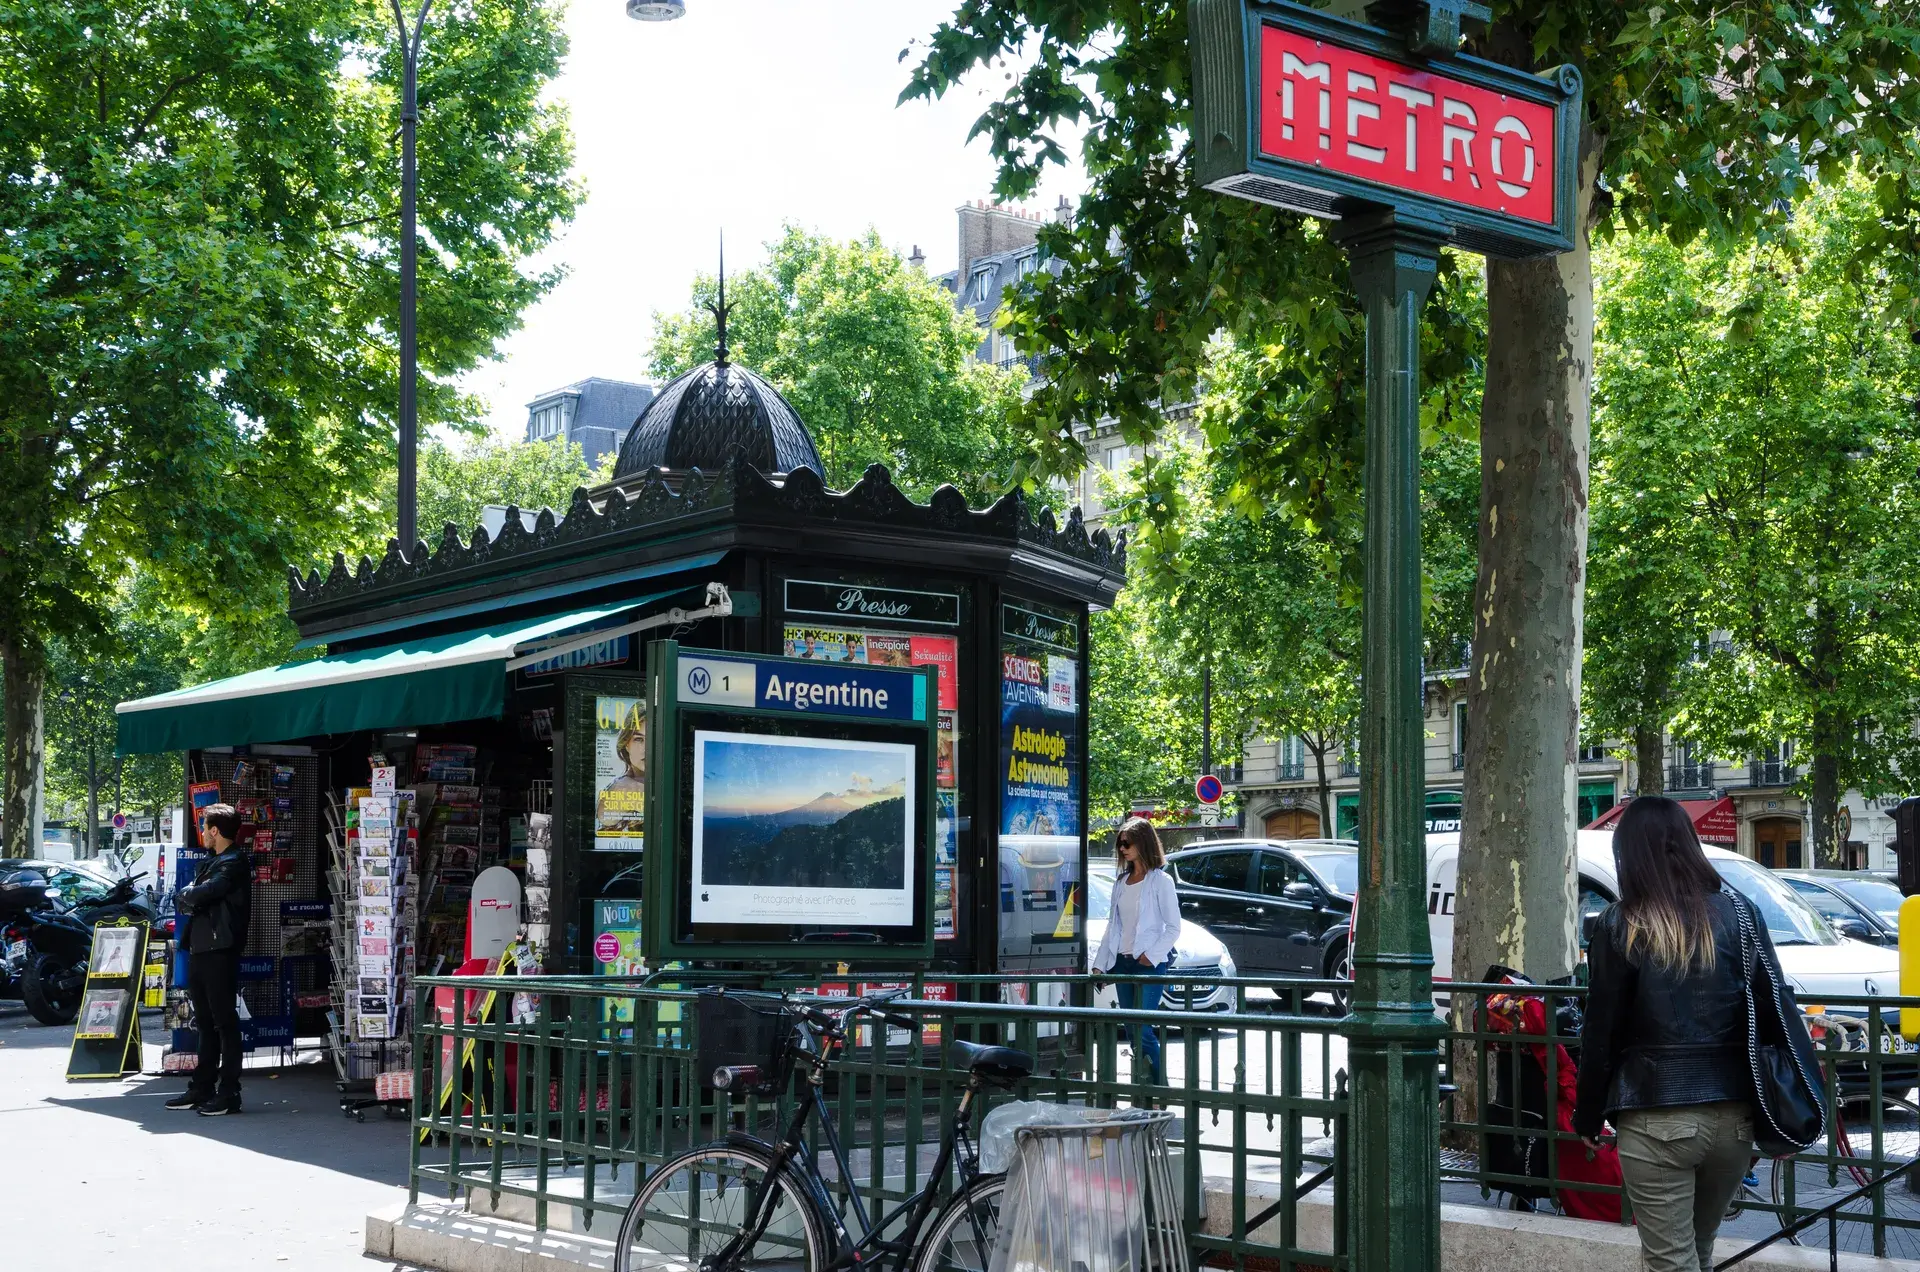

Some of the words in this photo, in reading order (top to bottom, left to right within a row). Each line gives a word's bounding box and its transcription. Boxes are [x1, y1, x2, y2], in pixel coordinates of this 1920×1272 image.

[1282, 50, 1535, 198] METRO
[837, 588, 911, 616] Presse
[1025, 615, 1056, 641] Presse
[869, 639, 910, 652] inexploré
[914, 650, 953, 662] Sexualité
[1004, 656, 1041, 684] SCIENCES
[722, 675, 730, 691] 1
[765, 674, 889, 709] Argentine
[1006, 681, 1041, 705] AVENIR
[1012, 725, 1066, 761] Astrologie
[1008, 755, 1069, 787] Astronomie
[600, 791, 625, 801] PLEIN
[1008, 785, 1014, 796] La
[1014, 785, 1031, 798] science
[1031, 787, 1040, 798] face
[604, 800, 619, 811] SUR
[620, 801, 635, 812] MES
[753, 893, 804, 906] Photographié
[805, 895, 822, 904] avec
[822, 894, 851, 905] l'iPhone
[850, 895, 857, 906] 6
[240, 962, 272, 973] Monde
[257, 1027, 289, 1037] Monde
